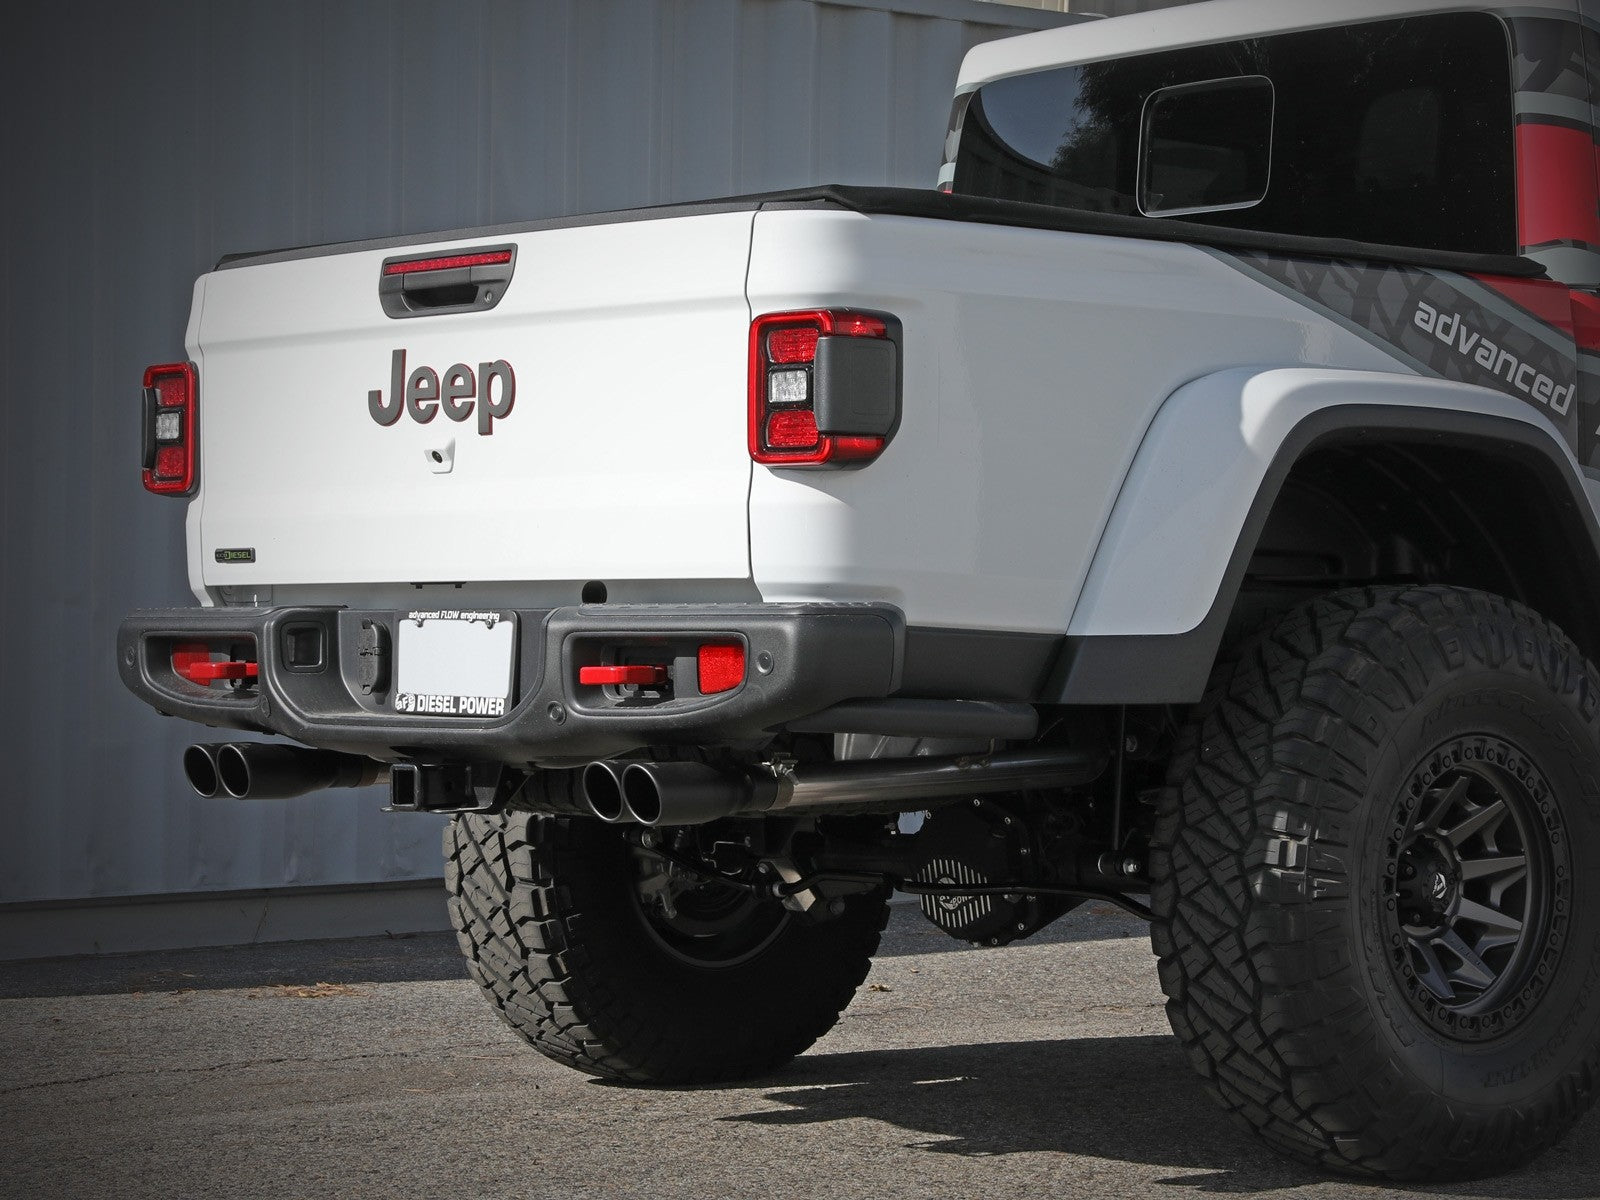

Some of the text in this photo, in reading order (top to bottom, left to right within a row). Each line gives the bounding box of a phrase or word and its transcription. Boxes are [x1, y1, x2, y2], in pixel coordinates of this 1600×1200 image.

[1414, 300, 1576, 416] advanced
[367, 349, 516, 436] Jeep
[408, 610, 500, 623] advanced FLOW engineering
[416, 695, 456, 713] DIESEL
[459, 697, 505, 715] POWER
